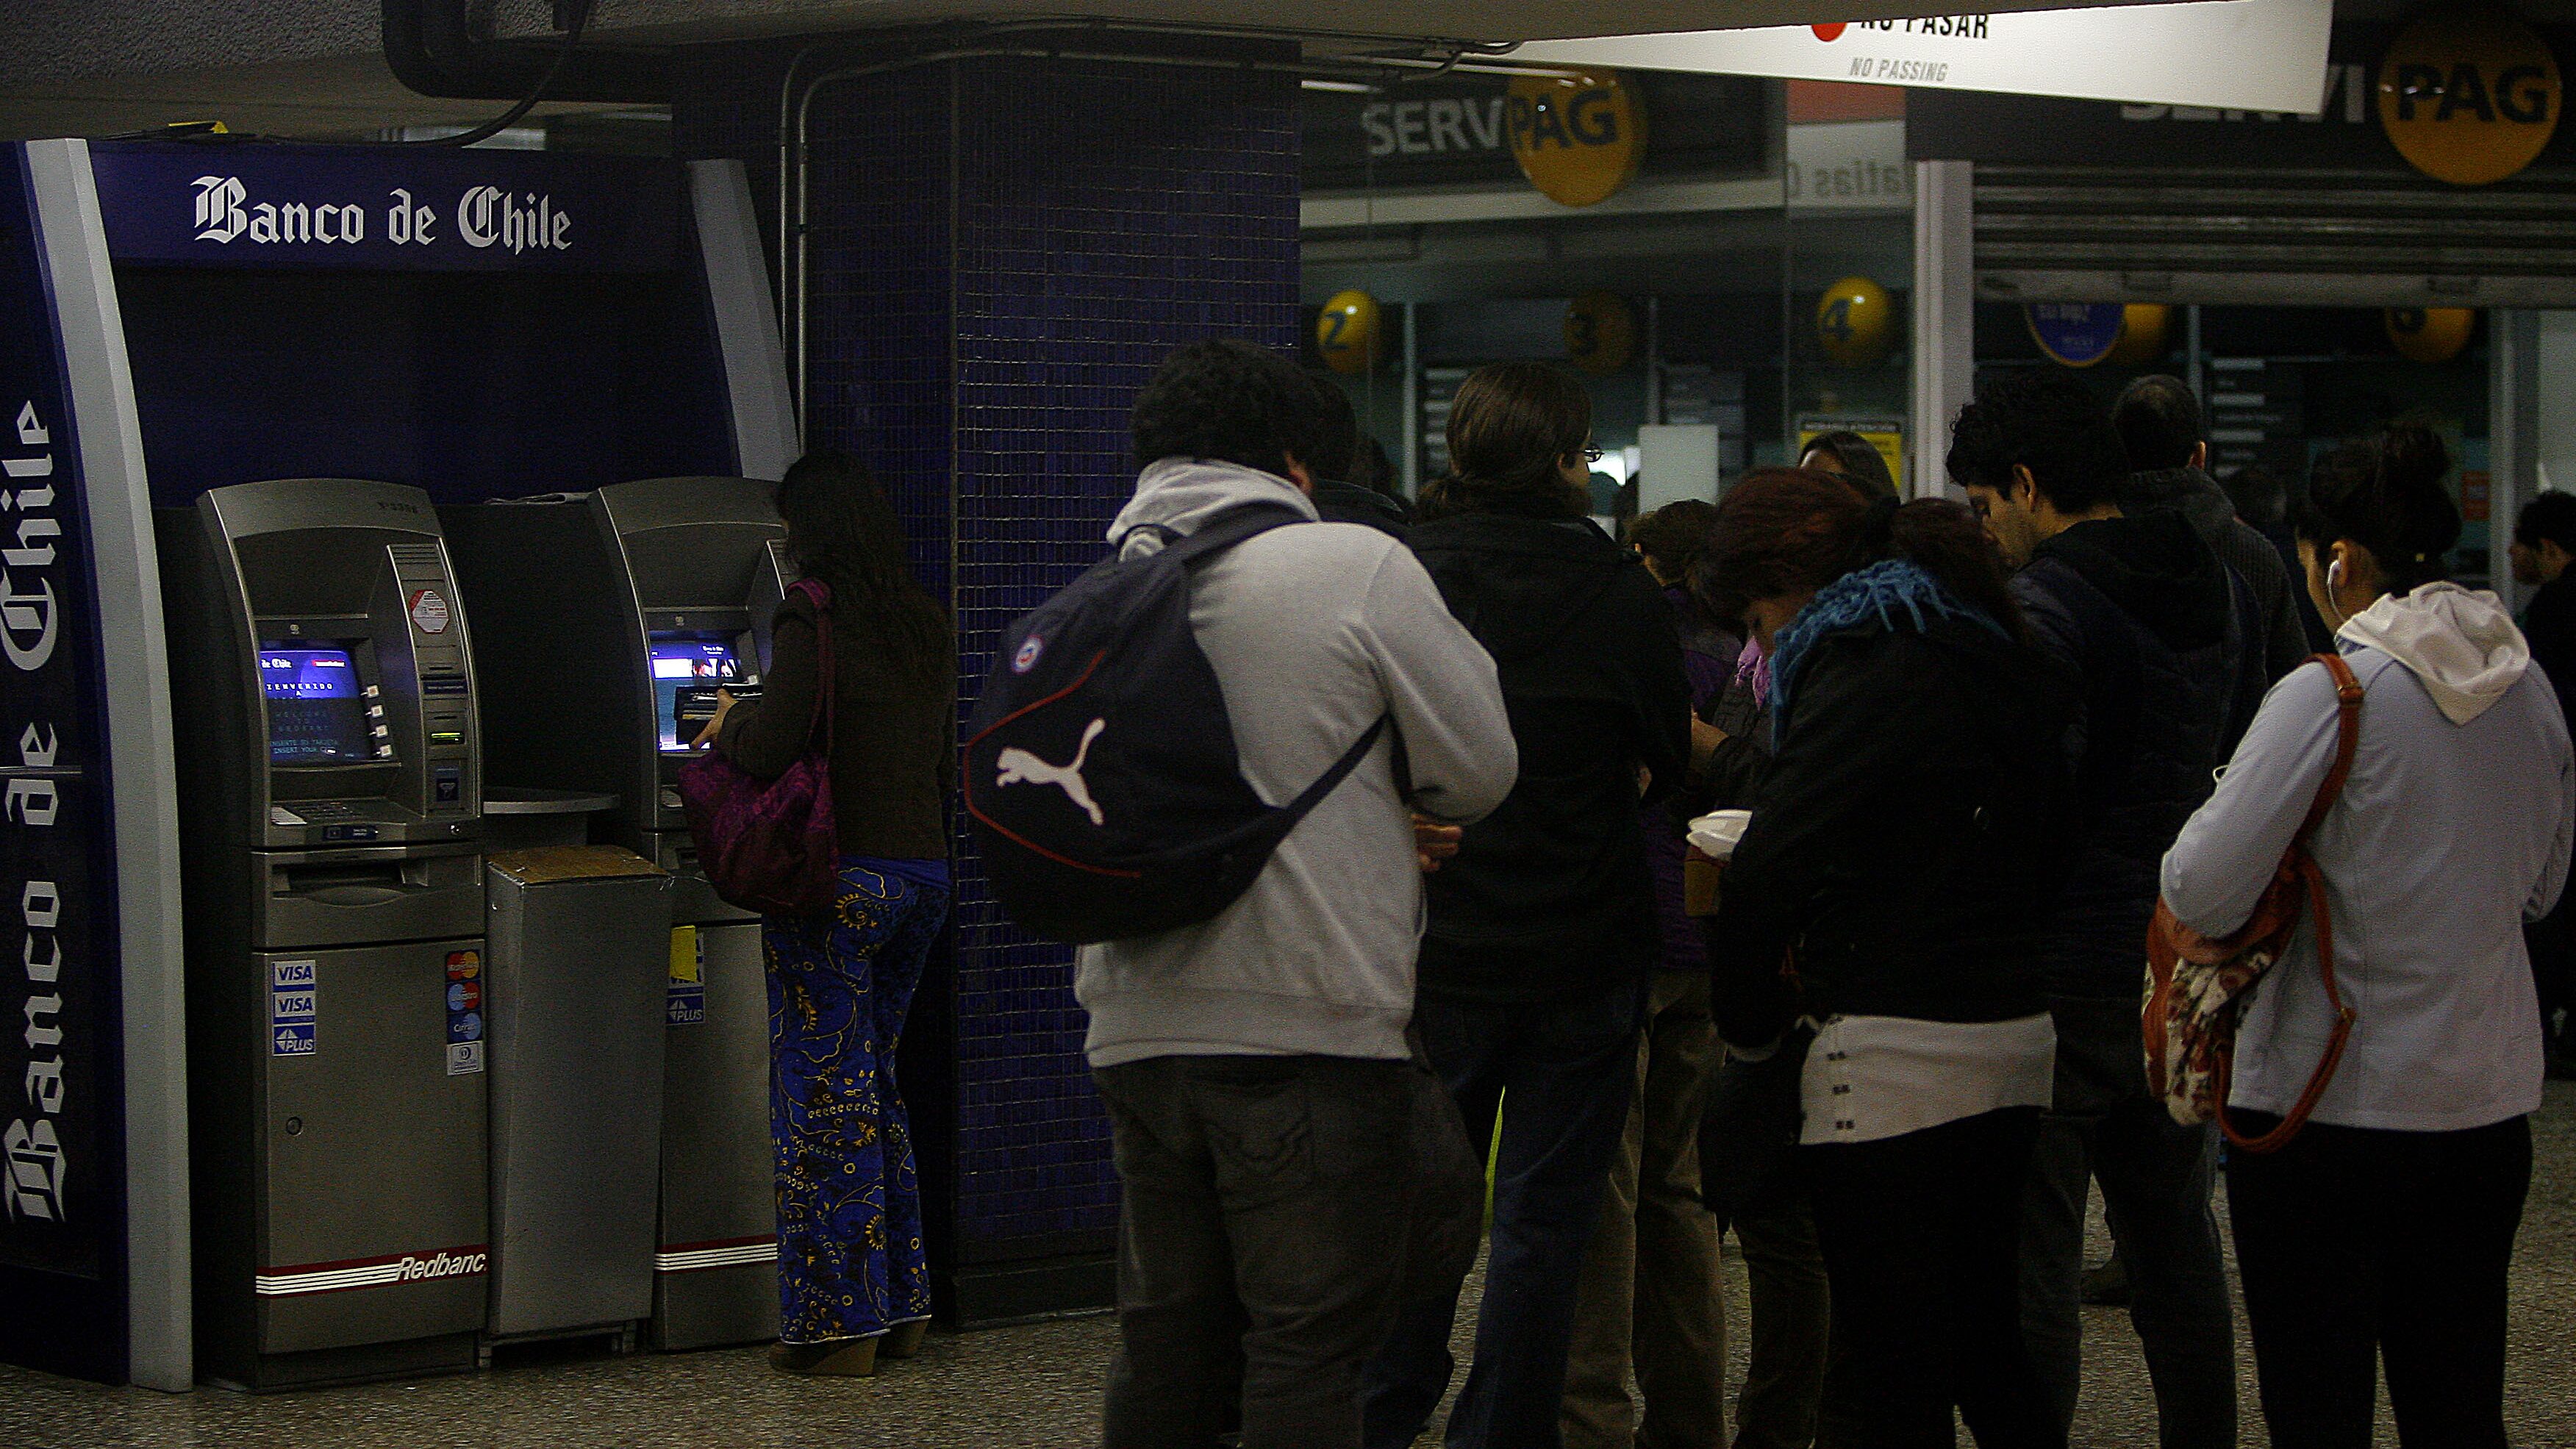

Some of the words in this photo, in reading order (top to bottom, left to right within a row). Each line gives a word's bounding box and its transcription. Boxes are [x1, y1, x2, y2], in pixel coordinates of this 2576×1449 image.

[1850, 58, 1872, 76] NO
[1878, 59, 1947, 81] PASSING
[2398, 63, 2548, 124] PAG
[1509, 89, 1619, 151] PAG
[190, 175, 365, 244] Banco
[388, 187, 437, 246] de
[457, 184, 573, 256] Chile
[1323, 312, 1348, 351] 2
[1819, 298, 1853, 340] 4
[0, 399, 60, 671] Chile
[4, 721, 60, 826] de
[278, 966, 312, 980] VISA
[279, 998, 313, 1012] VISA
[676, 1009, 703, 1021] PLUS
[4, 880, 68, 1224] Banco
[286, 1039, 313, 1051] PLUS
[398, 1253, 486, 1280] Redbanc
